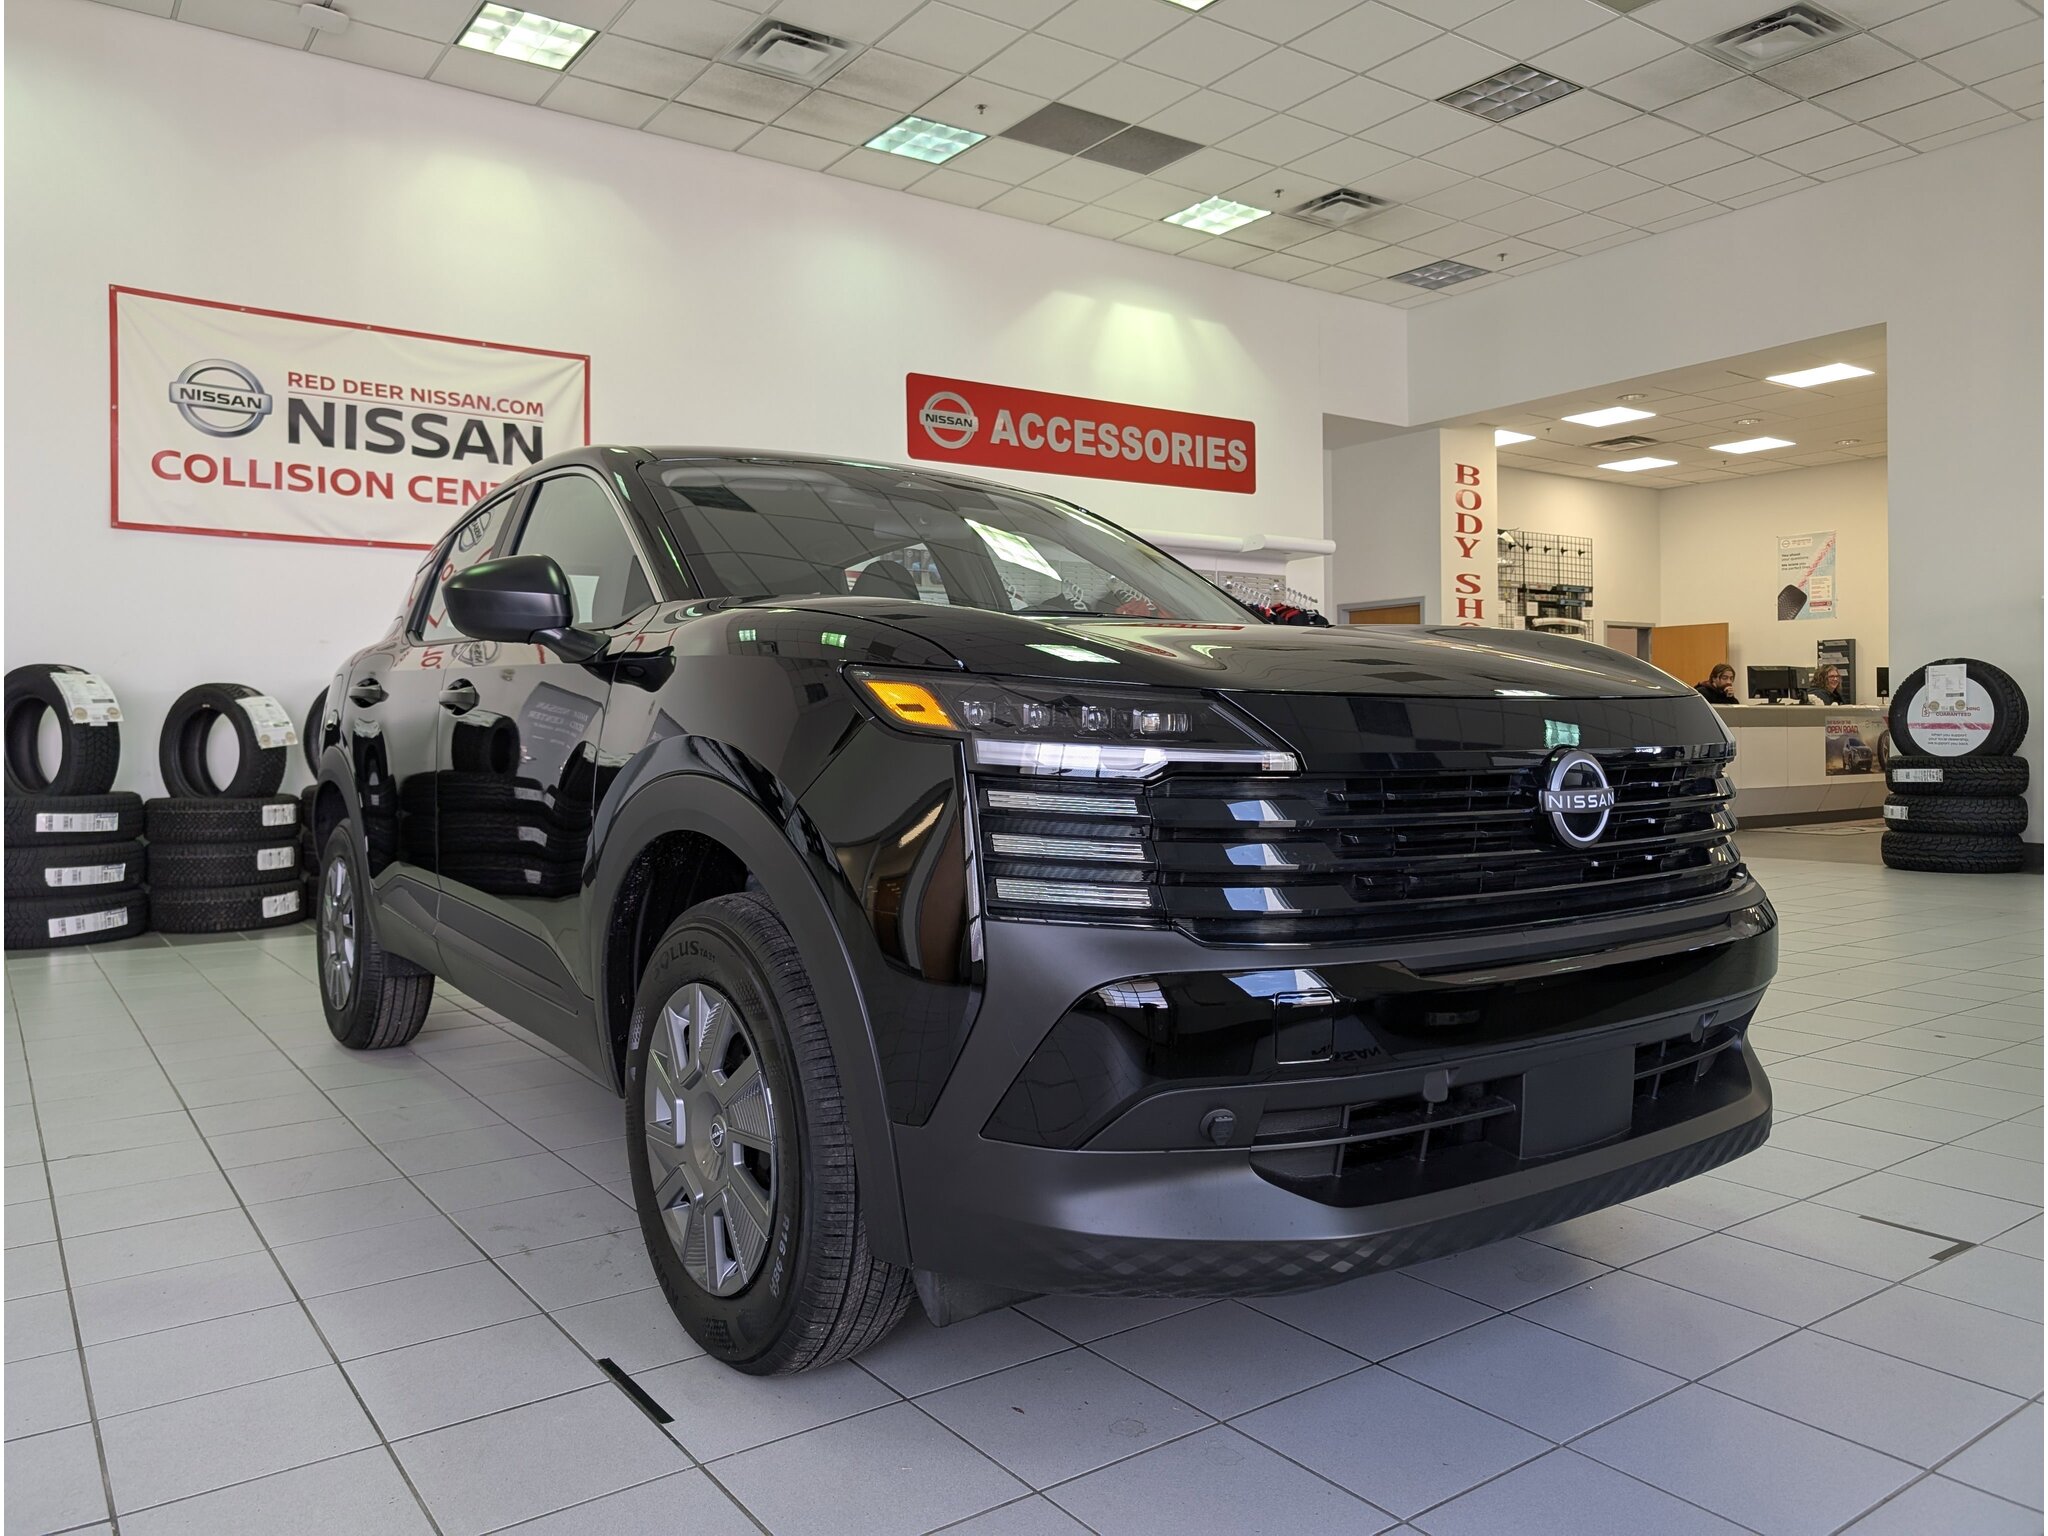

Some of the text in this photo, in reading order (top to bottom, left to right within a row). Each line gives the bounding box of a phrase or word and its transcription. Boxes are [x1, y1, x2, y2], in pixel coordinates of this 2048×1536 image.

[180, 386, 262, 410] NISSAN
[288, 371, 544, 417] RED DEER NISSAN.COM
[288, 398, 544, 466] NISSAN
[925, 413, 973, 428] NISSAN
[990, 409, 1248, 473] ACCESSORIES
[151, 450, 503, 507] COLLISION CEN
[1454, 463, 1483, 559] BODY
[1456, 573, 1484, 626] SH
[1826, 725, 1859, 734] OPEN ROAD
[1548, 791, 1615, 809] NISSAN
